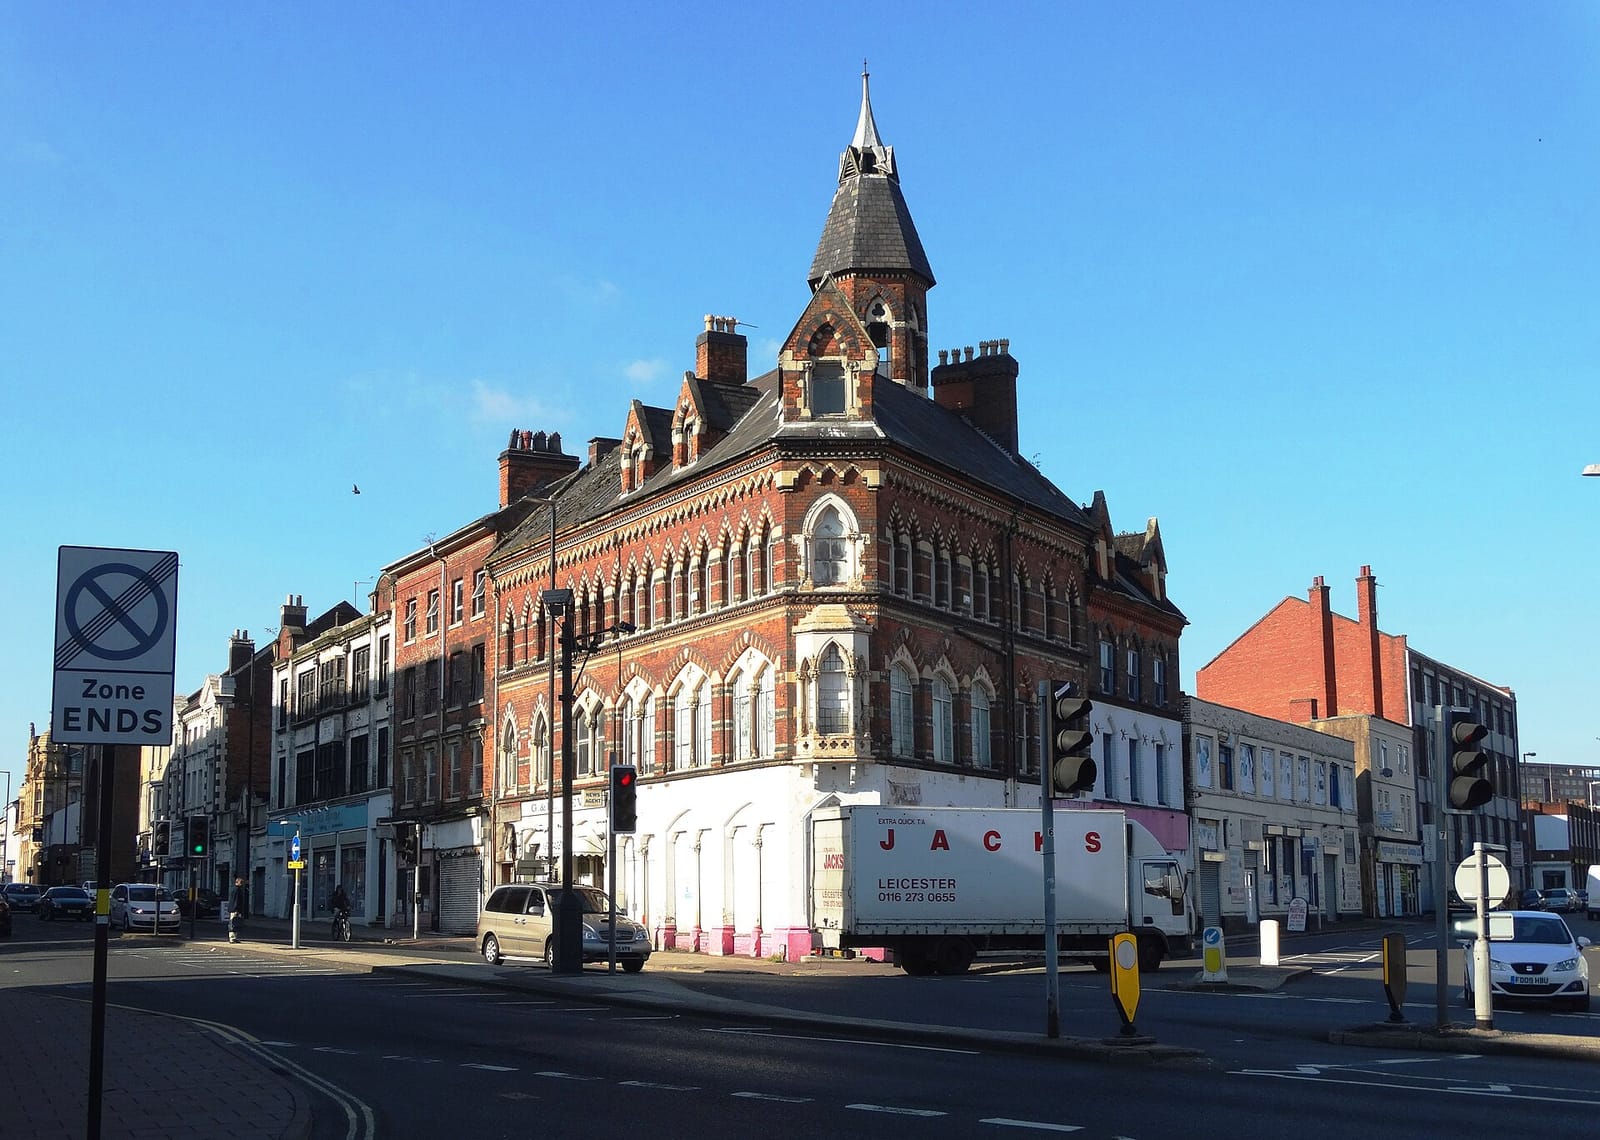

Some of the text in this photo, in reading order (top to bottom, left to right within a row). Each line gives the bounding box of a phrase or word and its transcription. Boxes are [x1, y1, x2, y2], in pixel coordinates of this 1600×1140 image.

[82, 678, 145, 700] Zone
[63, 706, 163, 734] ENDS
[1048, 828, 1054, 836] 6
[1440, 831, 1446, 839] 7
[823, 853, 844, 870] JACKS
[878, 878, 956, 889] LEICESTER
[878, 892, 956, 902] 0116 273 0655
